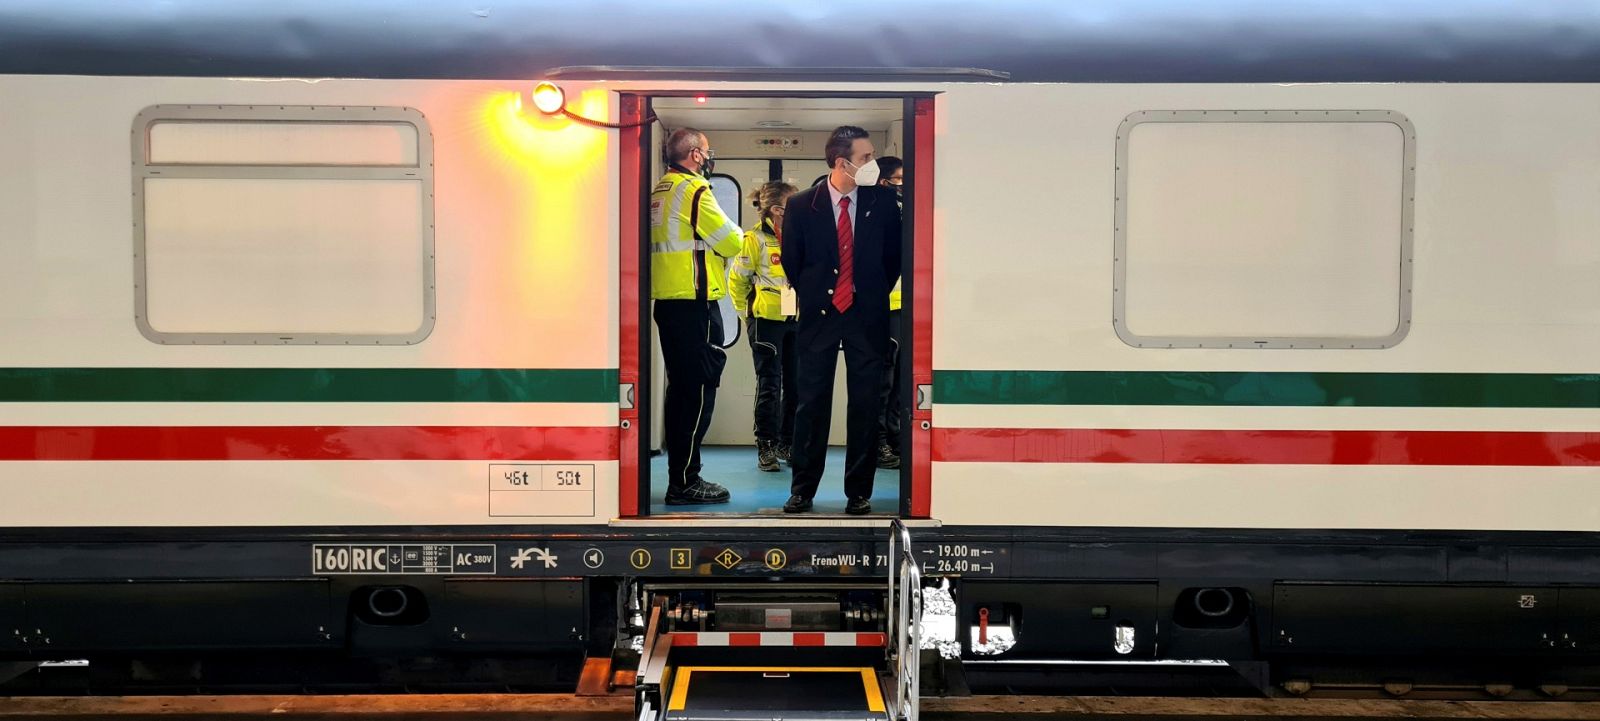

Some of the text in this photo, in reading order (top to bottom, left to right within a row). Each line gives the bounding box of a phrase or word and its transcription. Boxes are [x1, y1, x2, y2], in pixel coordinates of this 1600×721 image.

[504, 471, 528, 485] 46t
[556, 471, 581, 485] 50t
[938, 545, 980, 557] 19.00 m
[315, 548, 349, 570] 160
[352, 548, 386, 570] RIC
[456, 553, 492, 566] AC 380V
[638, 552, 643, 565] 1
[677, 552, 685, 565] 3
[724, 553, 732, 565] R
[771, 553, 781, 565] D
[876, 555, 888, 566] 71
[938, 560, 980, 572] 26.40 m
